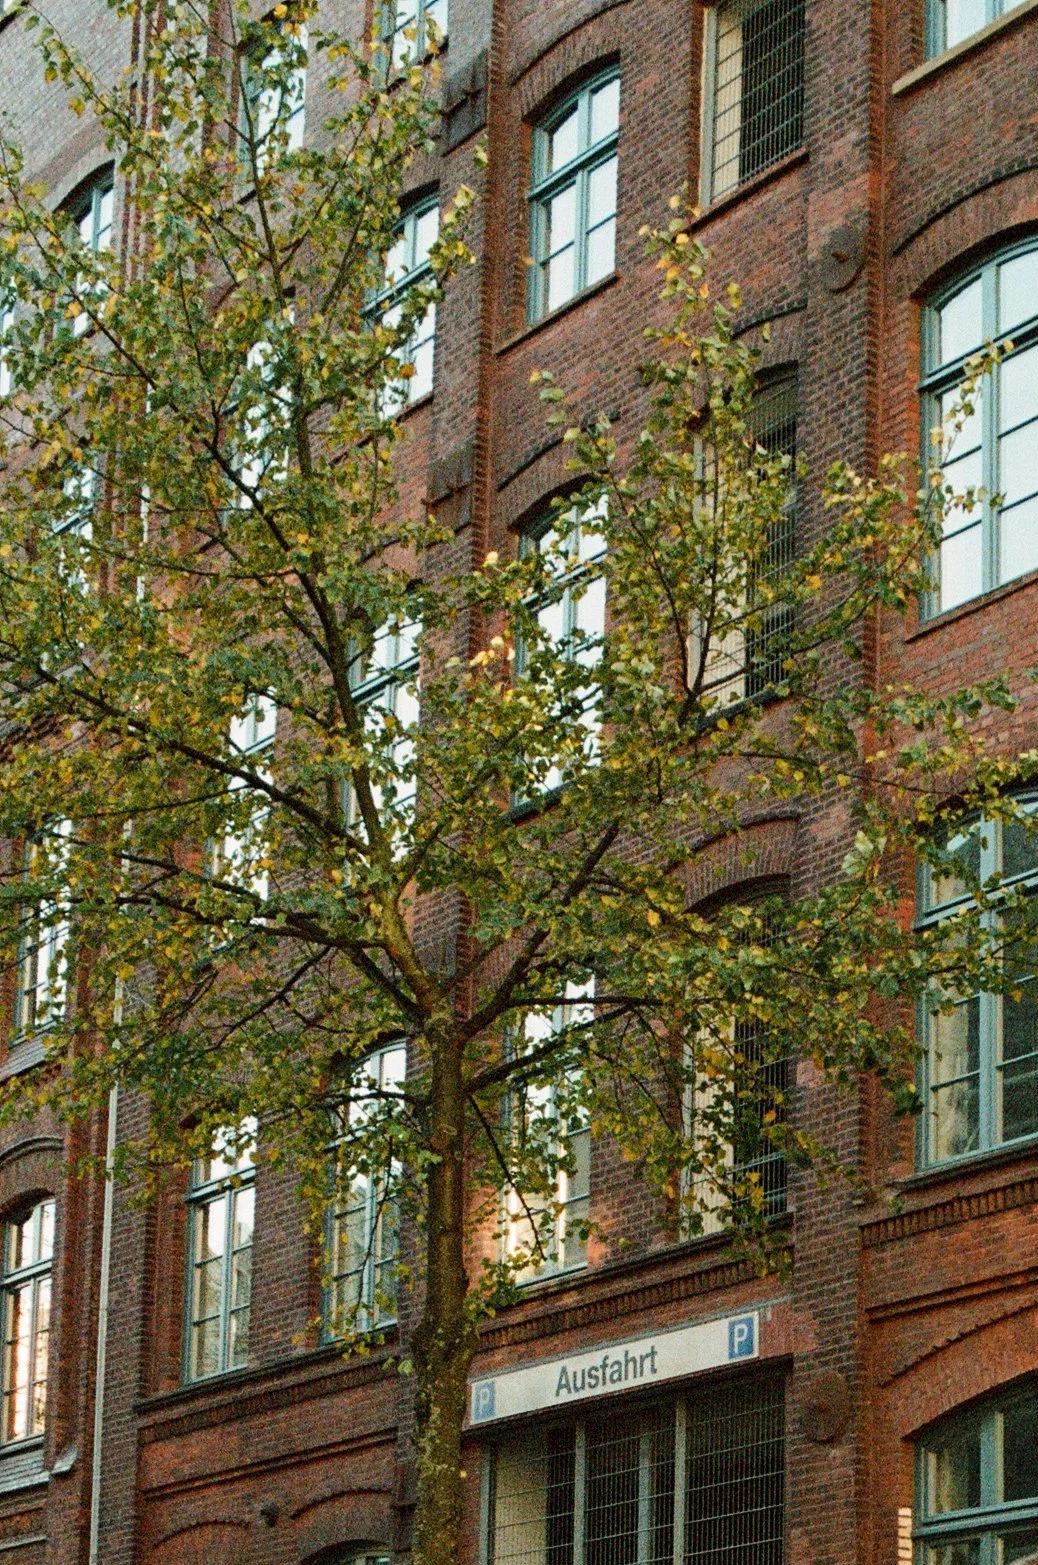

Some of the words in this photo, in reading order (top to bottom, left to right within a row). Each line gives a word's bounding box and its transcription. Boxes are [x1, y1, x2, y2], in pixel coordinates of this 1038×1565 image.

[479, 1388, 490, 1417] P
[555, 1345, 658, 1397] Ausfahrt
[733, 1323, 748, 1354] P
